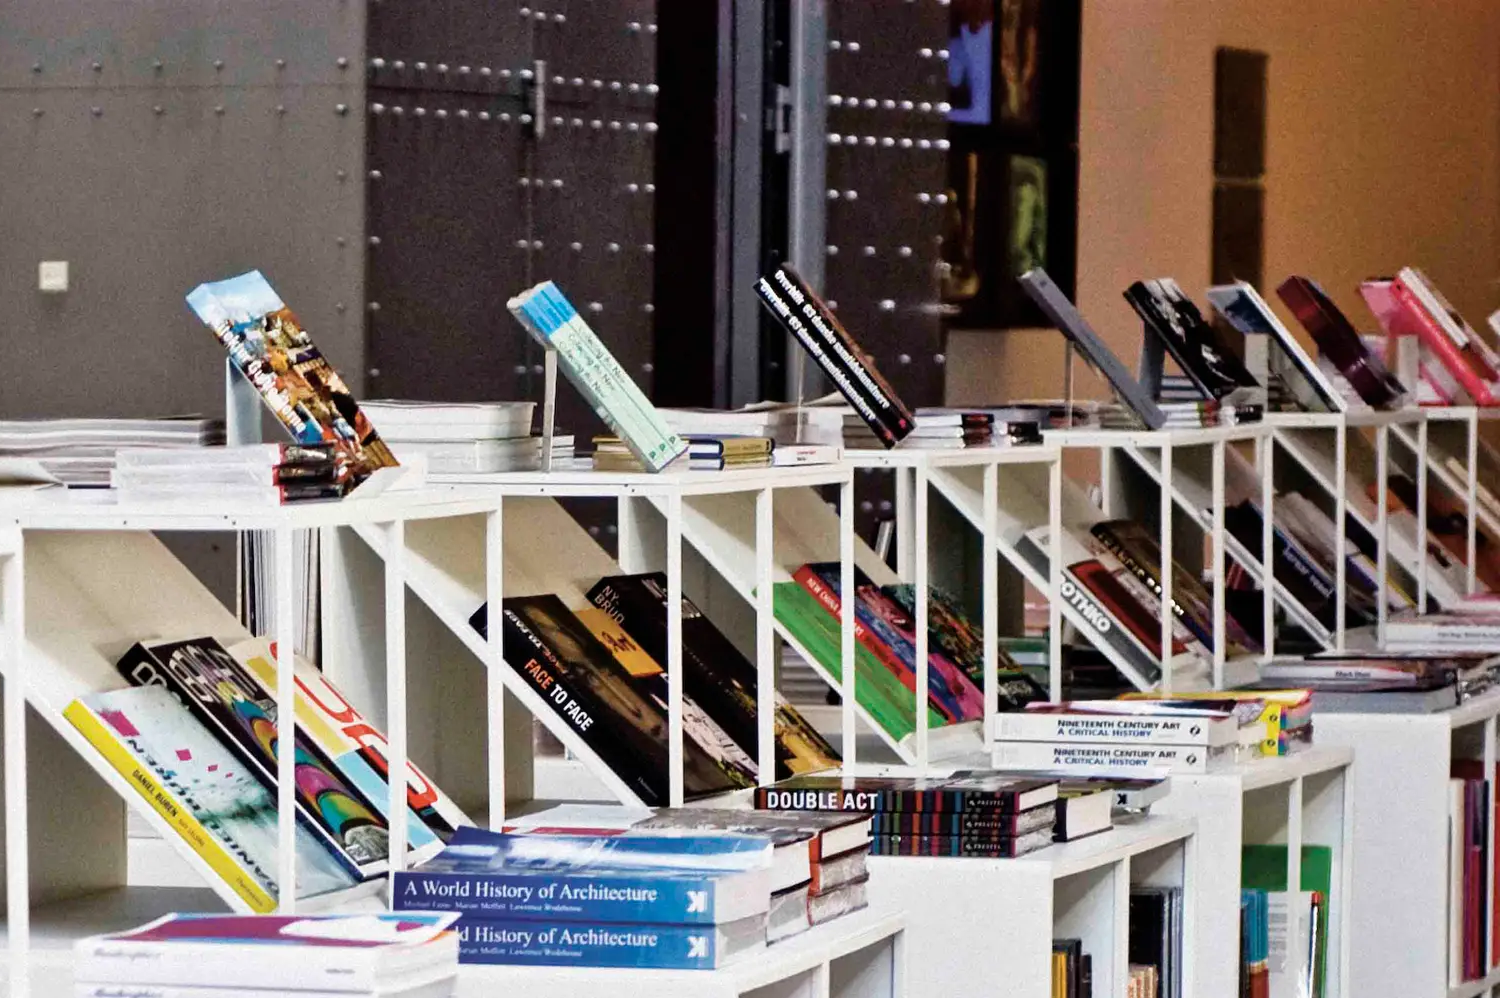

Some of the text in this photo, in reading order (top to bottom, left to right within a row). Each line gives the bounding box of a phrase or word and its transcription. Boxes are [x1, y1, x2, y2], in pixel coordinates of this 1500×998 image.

[524, 657, 594, 732] FACE TO FACE
[1056, 719, 1181, 730] NINETEENTH CENTURY ART
[1057, 727, 1152, 738] A CRITICAL HISTORY
[1053, 748, 1177, 759] NINETEENTH CENTURY ART
[1053, 756, 1149, 767] A CRITICAL HISTORY
[132, 769, 156, 796] DANIEL
[155, 791, 179, 818] BUREN
[767, 791, 879, 811] DOUBLE ACT
[404, 880, 658, 903] A World History of Architecture
[475, 927, 533, 949] History
[538, 927, 558, 945] of
[559, 928, 658, 948] Architecture
